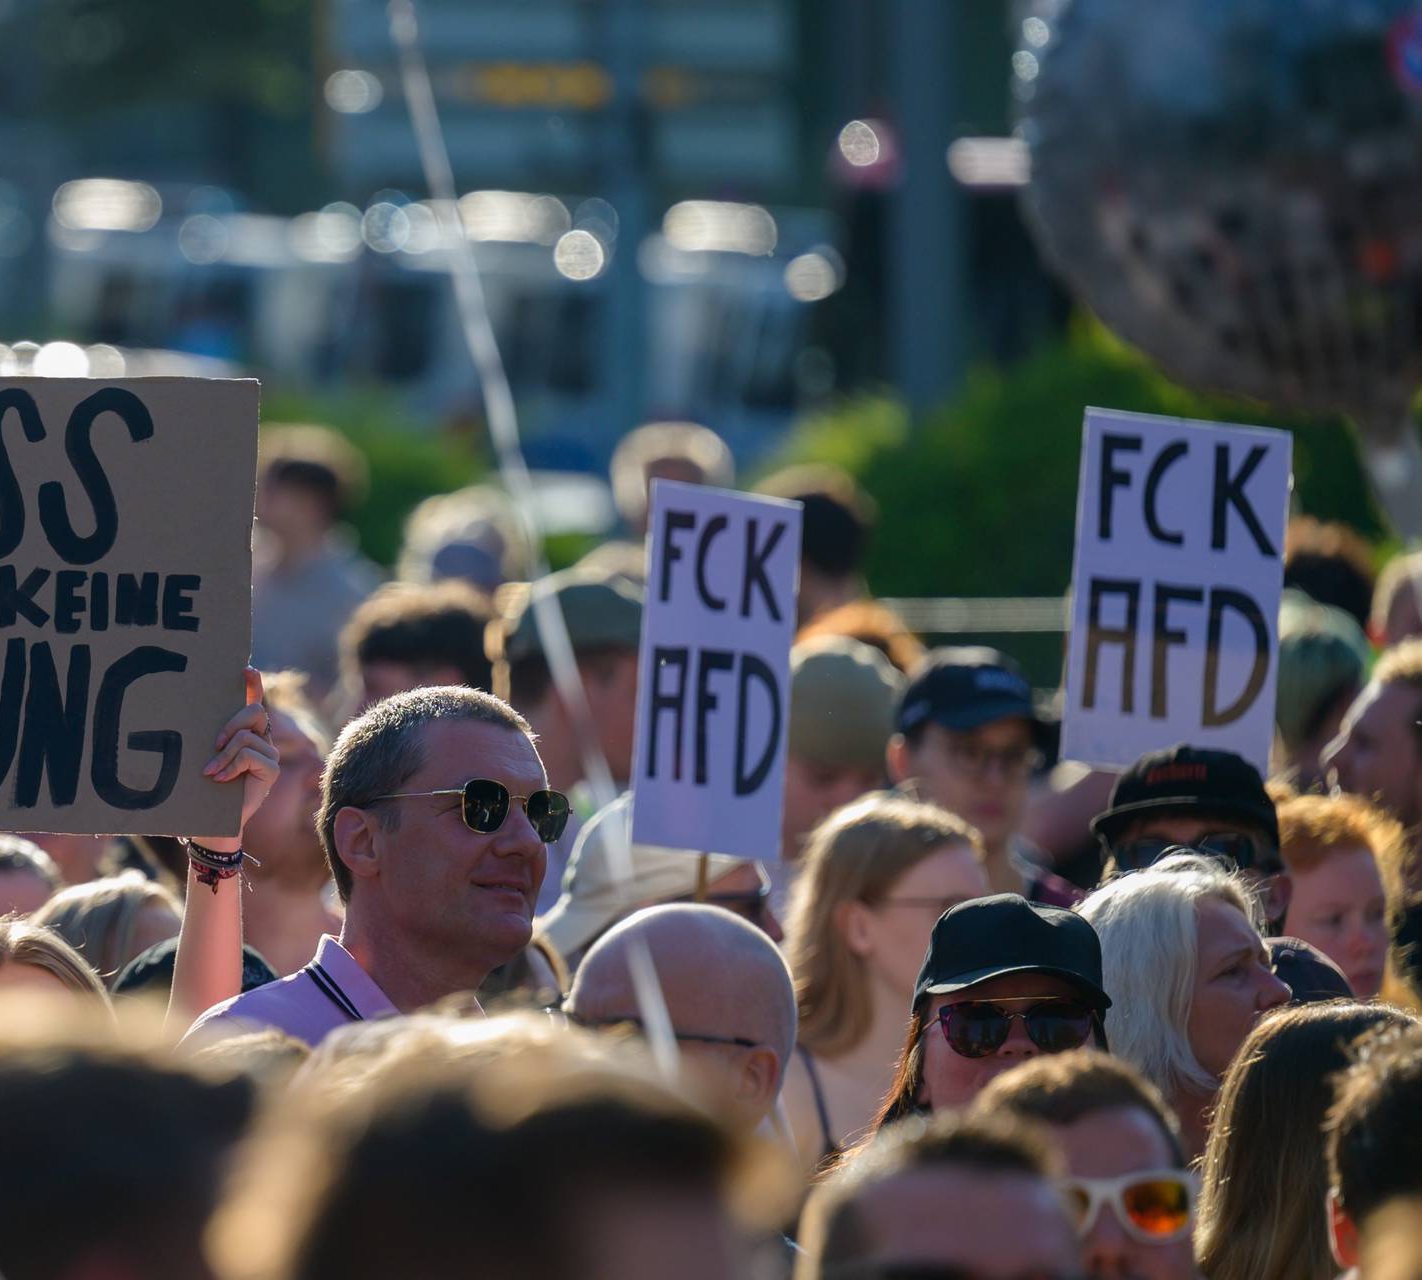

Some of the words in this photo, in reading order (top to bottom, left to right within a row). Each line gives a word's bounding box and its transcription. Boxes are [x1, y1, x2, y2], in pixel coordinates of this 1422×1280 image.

[1098, 434, 1277, 557] FCK
[660, 510, 788, 622] FCK
[1081, 577, 1270, 728] AFD
[644, 646, 782, 797] AFD
